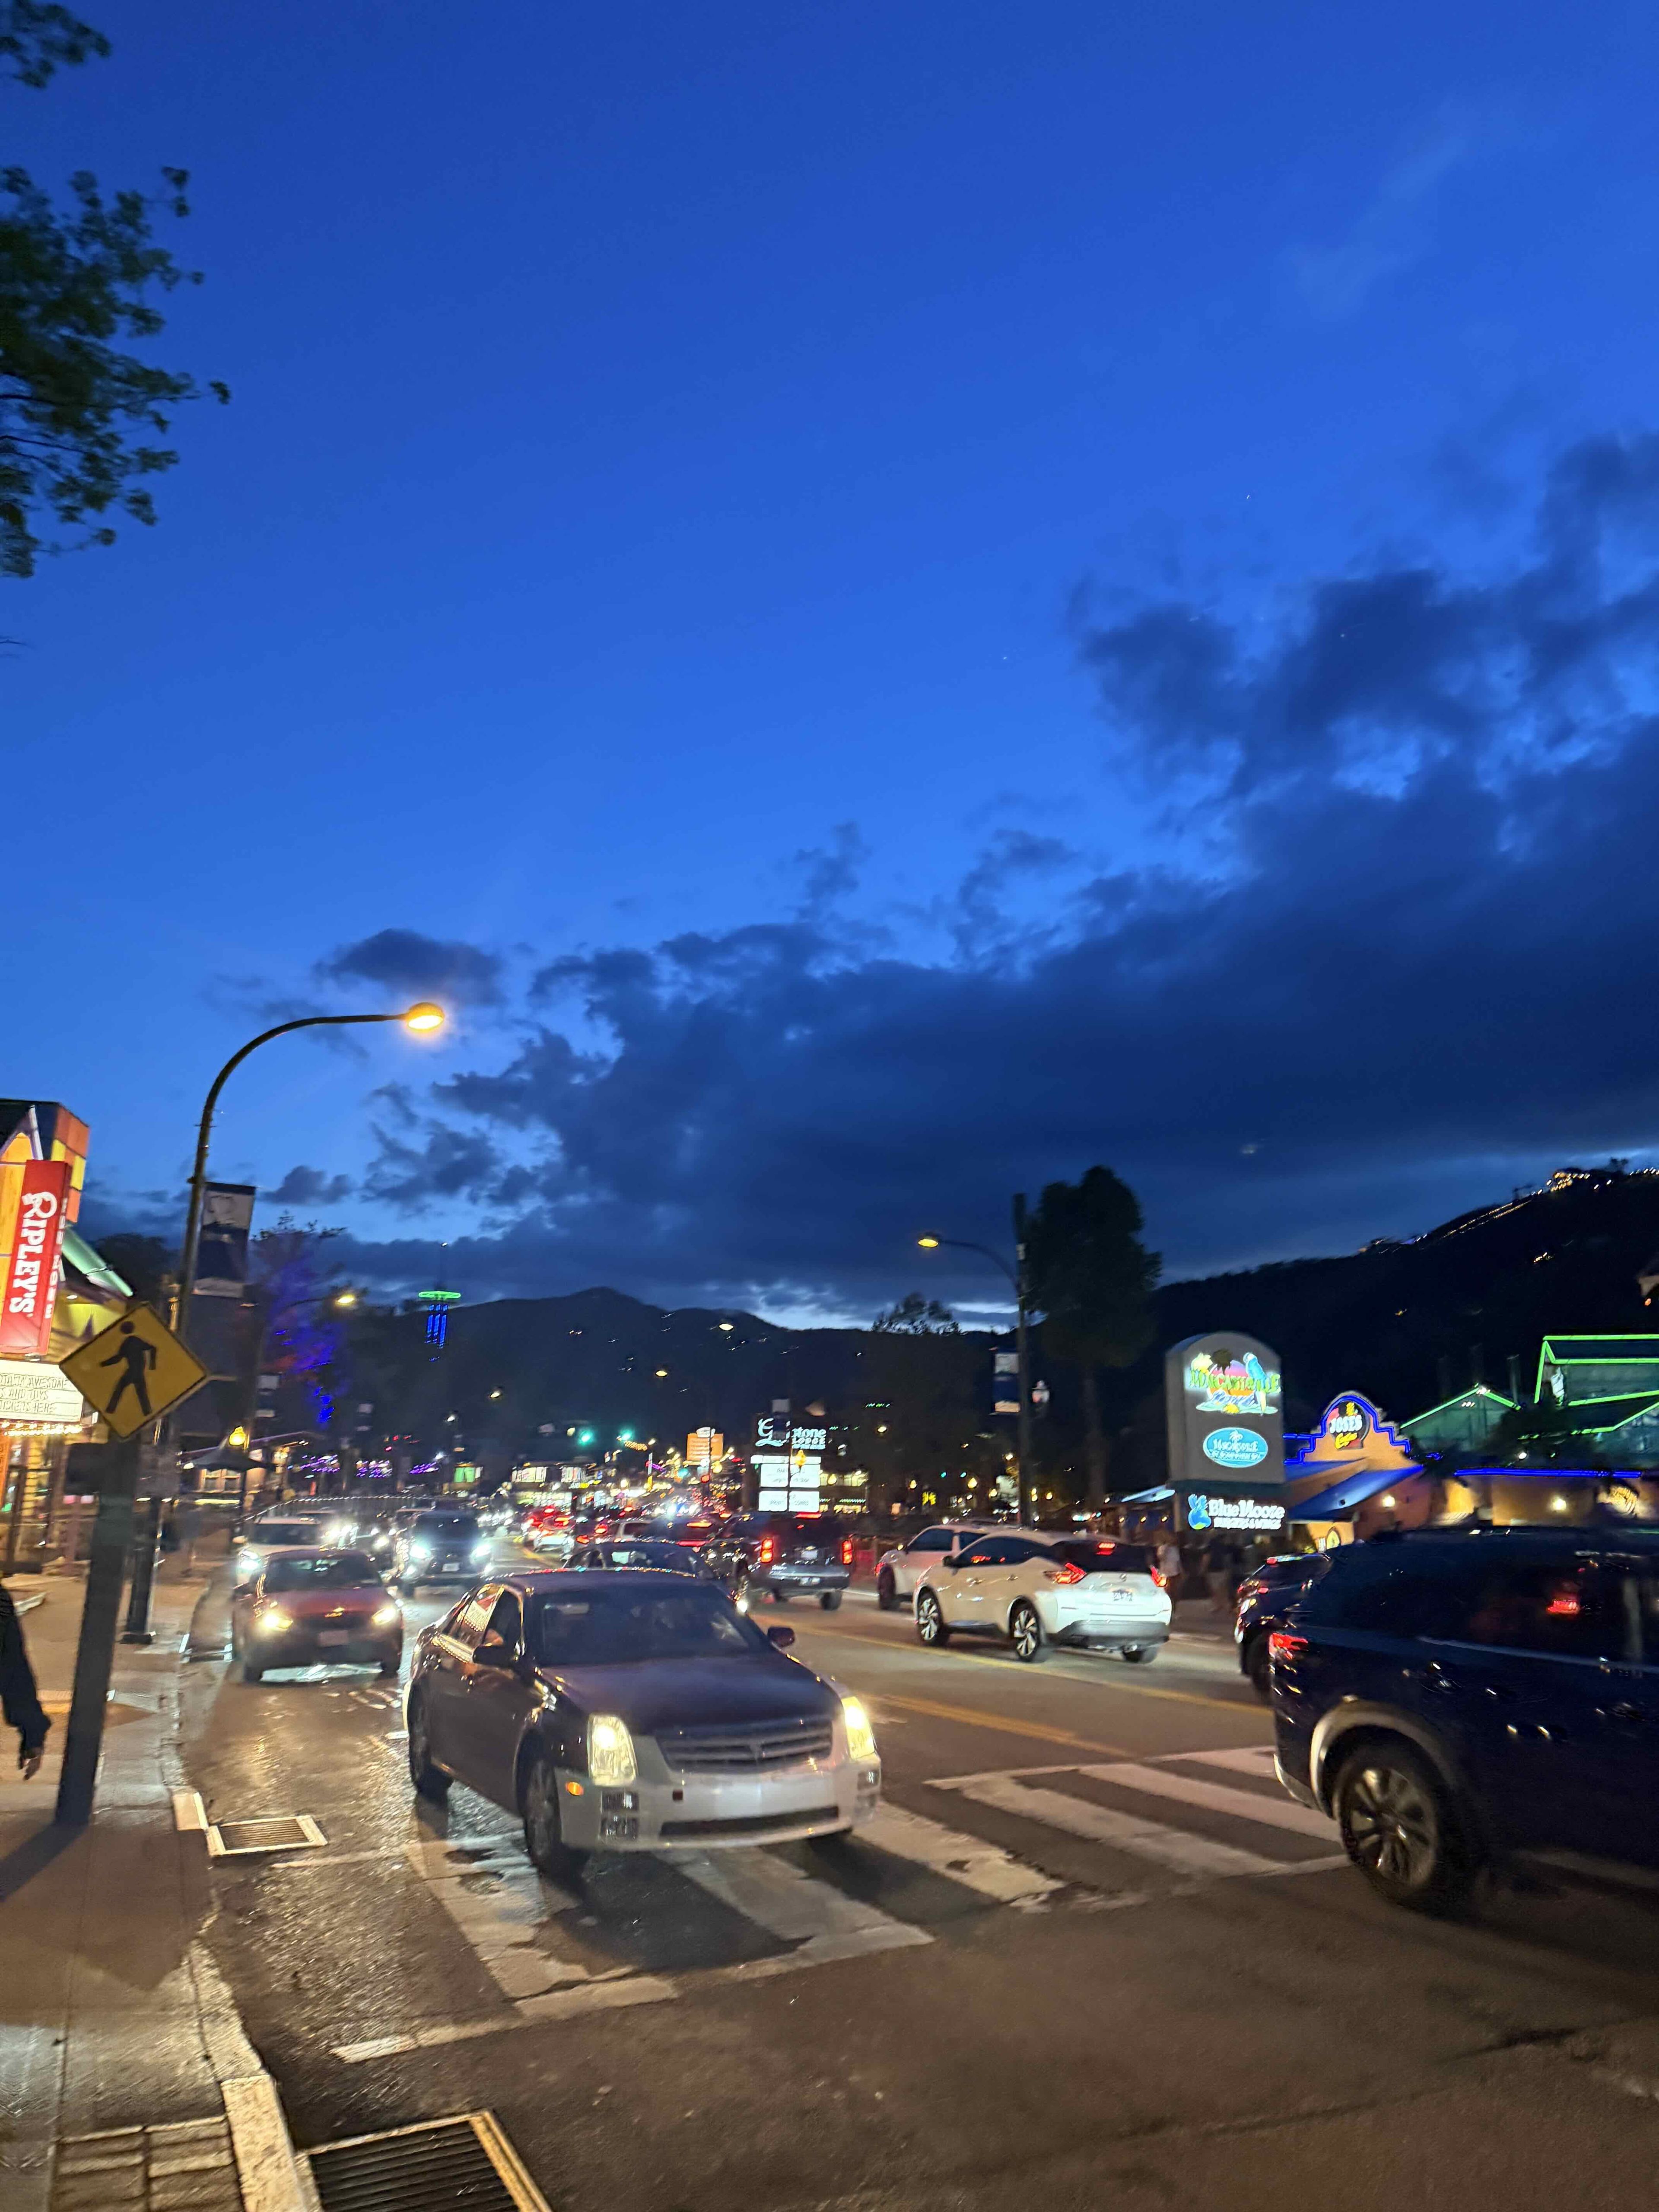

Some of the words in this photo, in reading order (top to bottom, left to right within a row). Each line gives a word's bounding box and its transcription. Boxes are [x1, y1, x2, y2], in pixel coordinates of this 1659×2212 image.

[9, 1192, 57, 1314] RIPLEY'S
[1208, 1499, 1240, 1516] Blue
[1239, 1500, 1285, 1519] Moose
